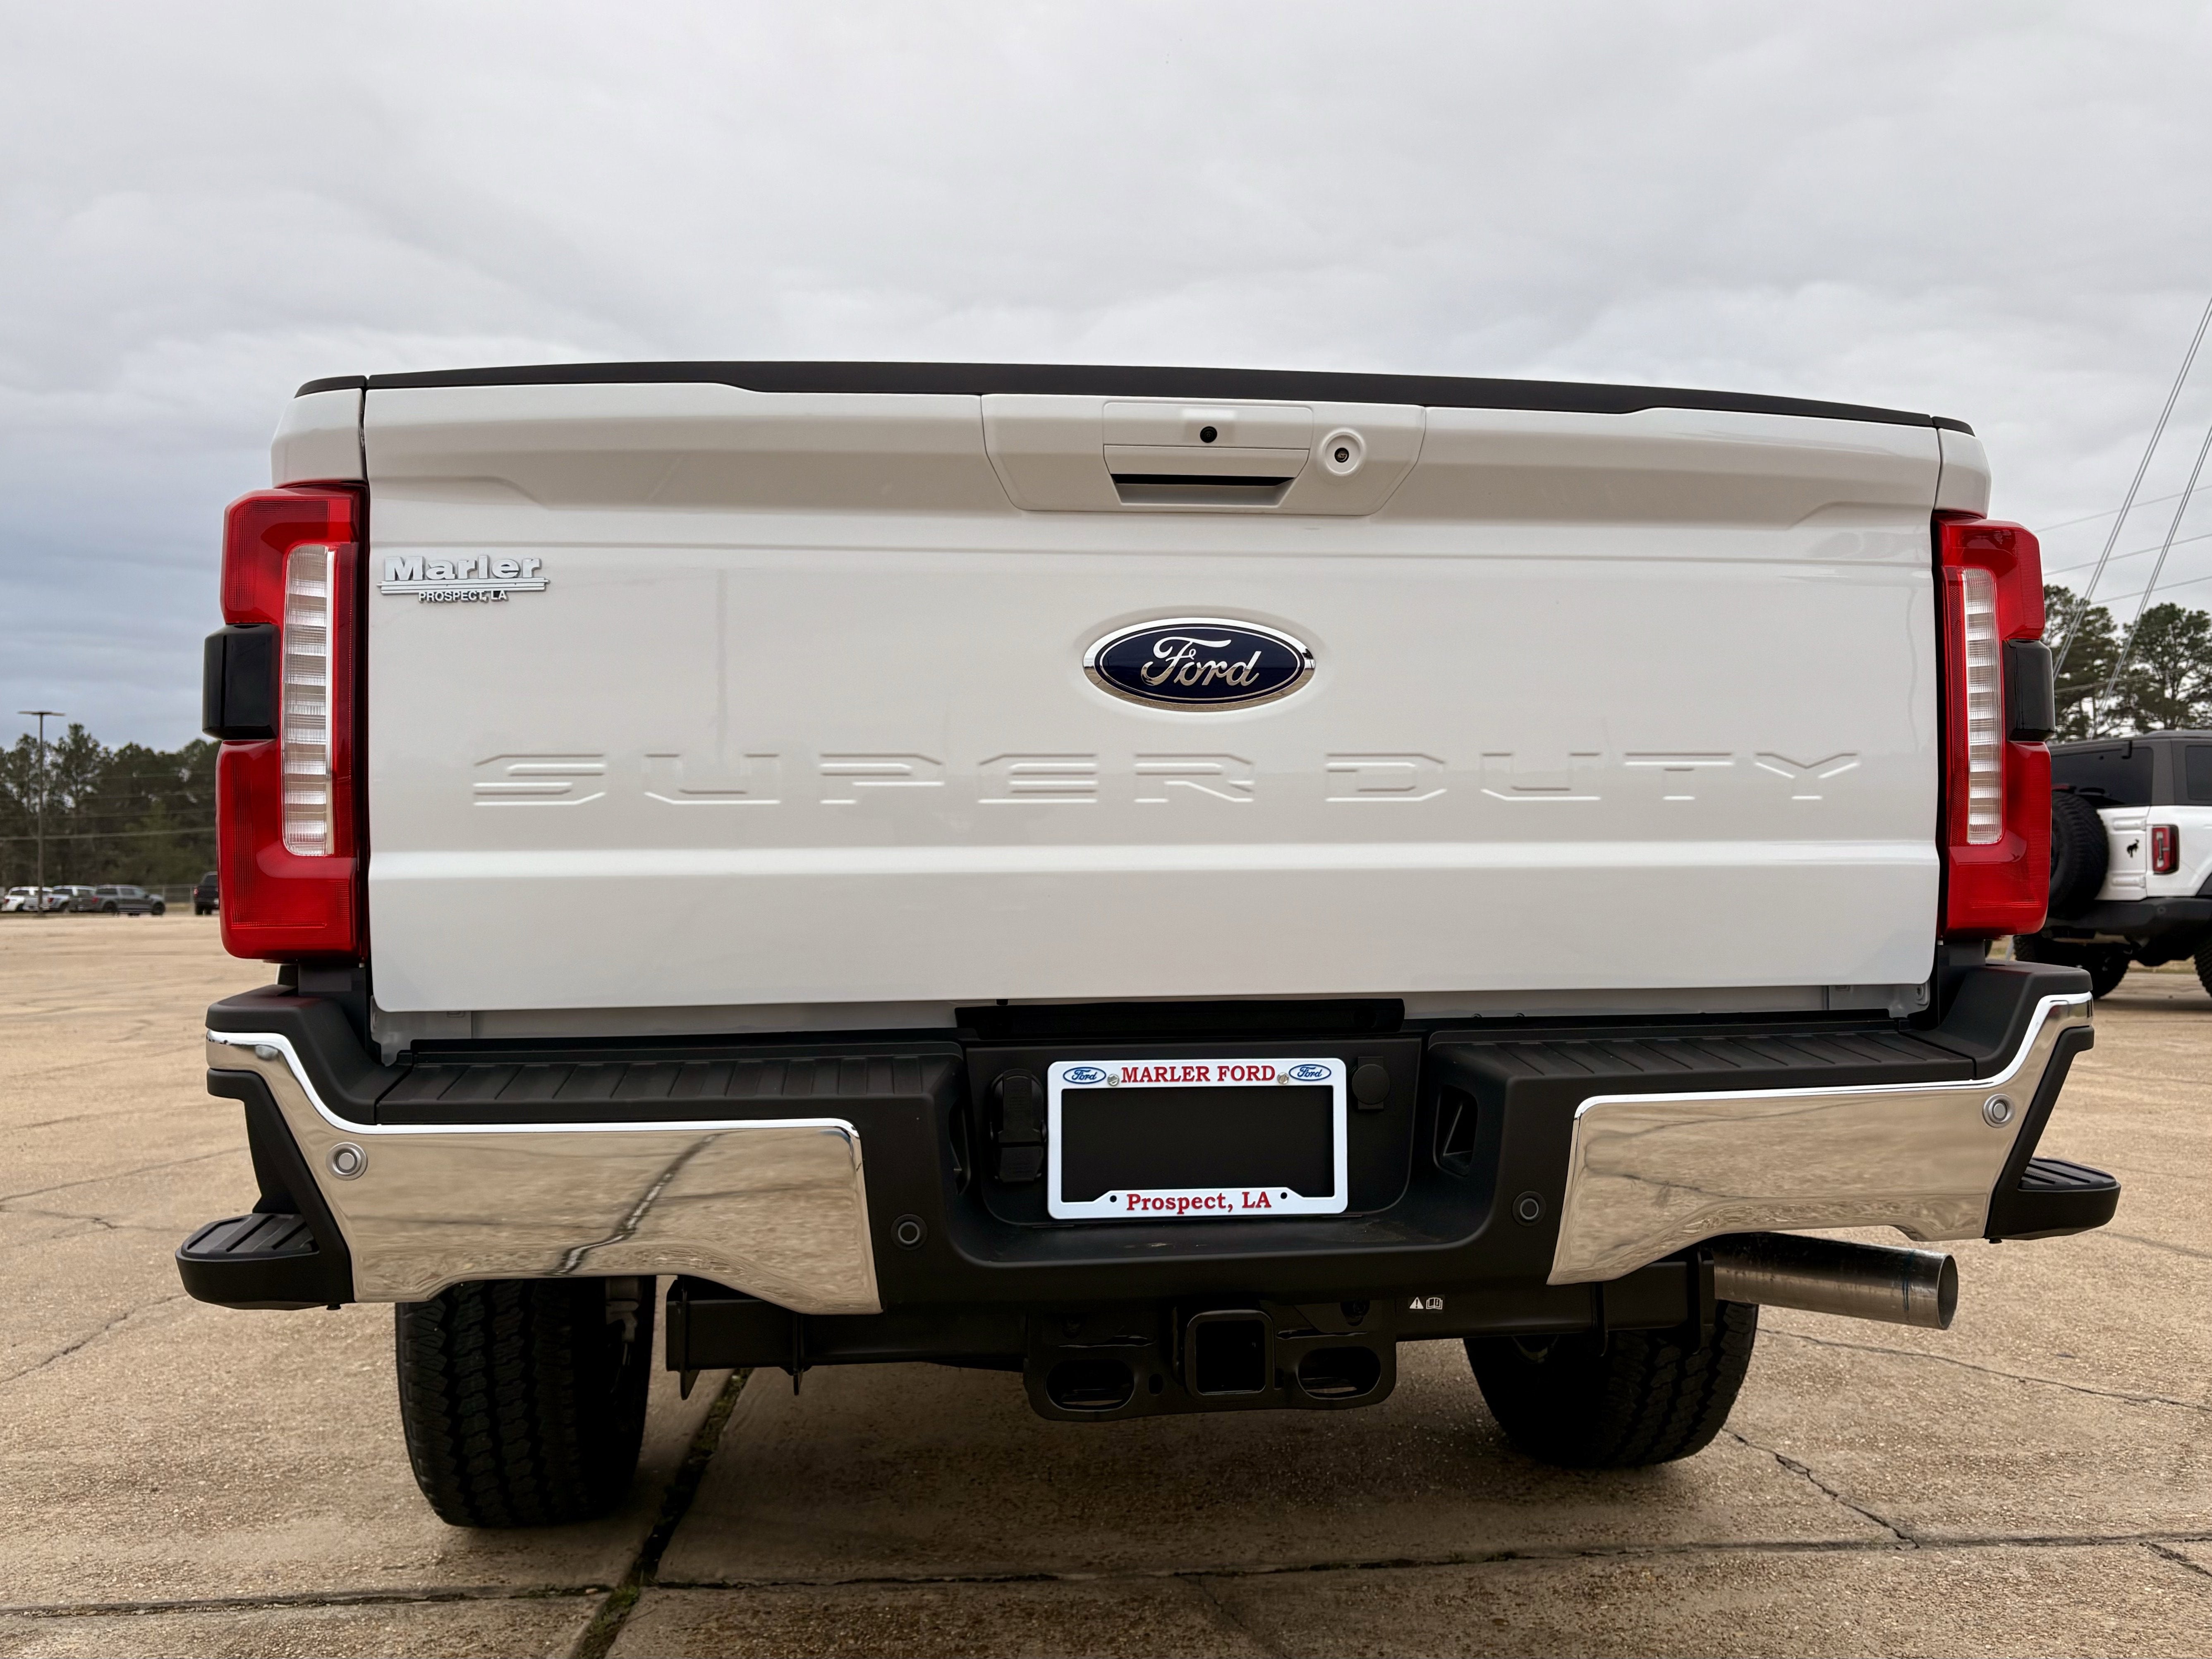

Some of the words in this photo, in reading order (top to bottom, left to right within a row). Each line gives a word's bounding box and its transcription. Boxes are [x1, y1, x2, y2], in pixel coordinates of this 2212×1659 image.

[385, 555, 541, 581] Marler
[419, 590, 488, 602] PROSPECT,
[491, 590, 508, 601] LA
[1141, 637, 1262, 686] Ford
[474, 753, 1254, 805] SUPER
[1326, 752, 1860, 802] DUTY
[1071, 1070, 1097, 1080] Ford
[1121, 1065, 1210, 1083] MARLER
[1217, 1065, 1276, 1082] FORD
[1297, 1066, 1322, 1077] Ford
[1127, 1193, 1233, 1214] Prospect,
[1242, 1192, 1271, 1209] LA
